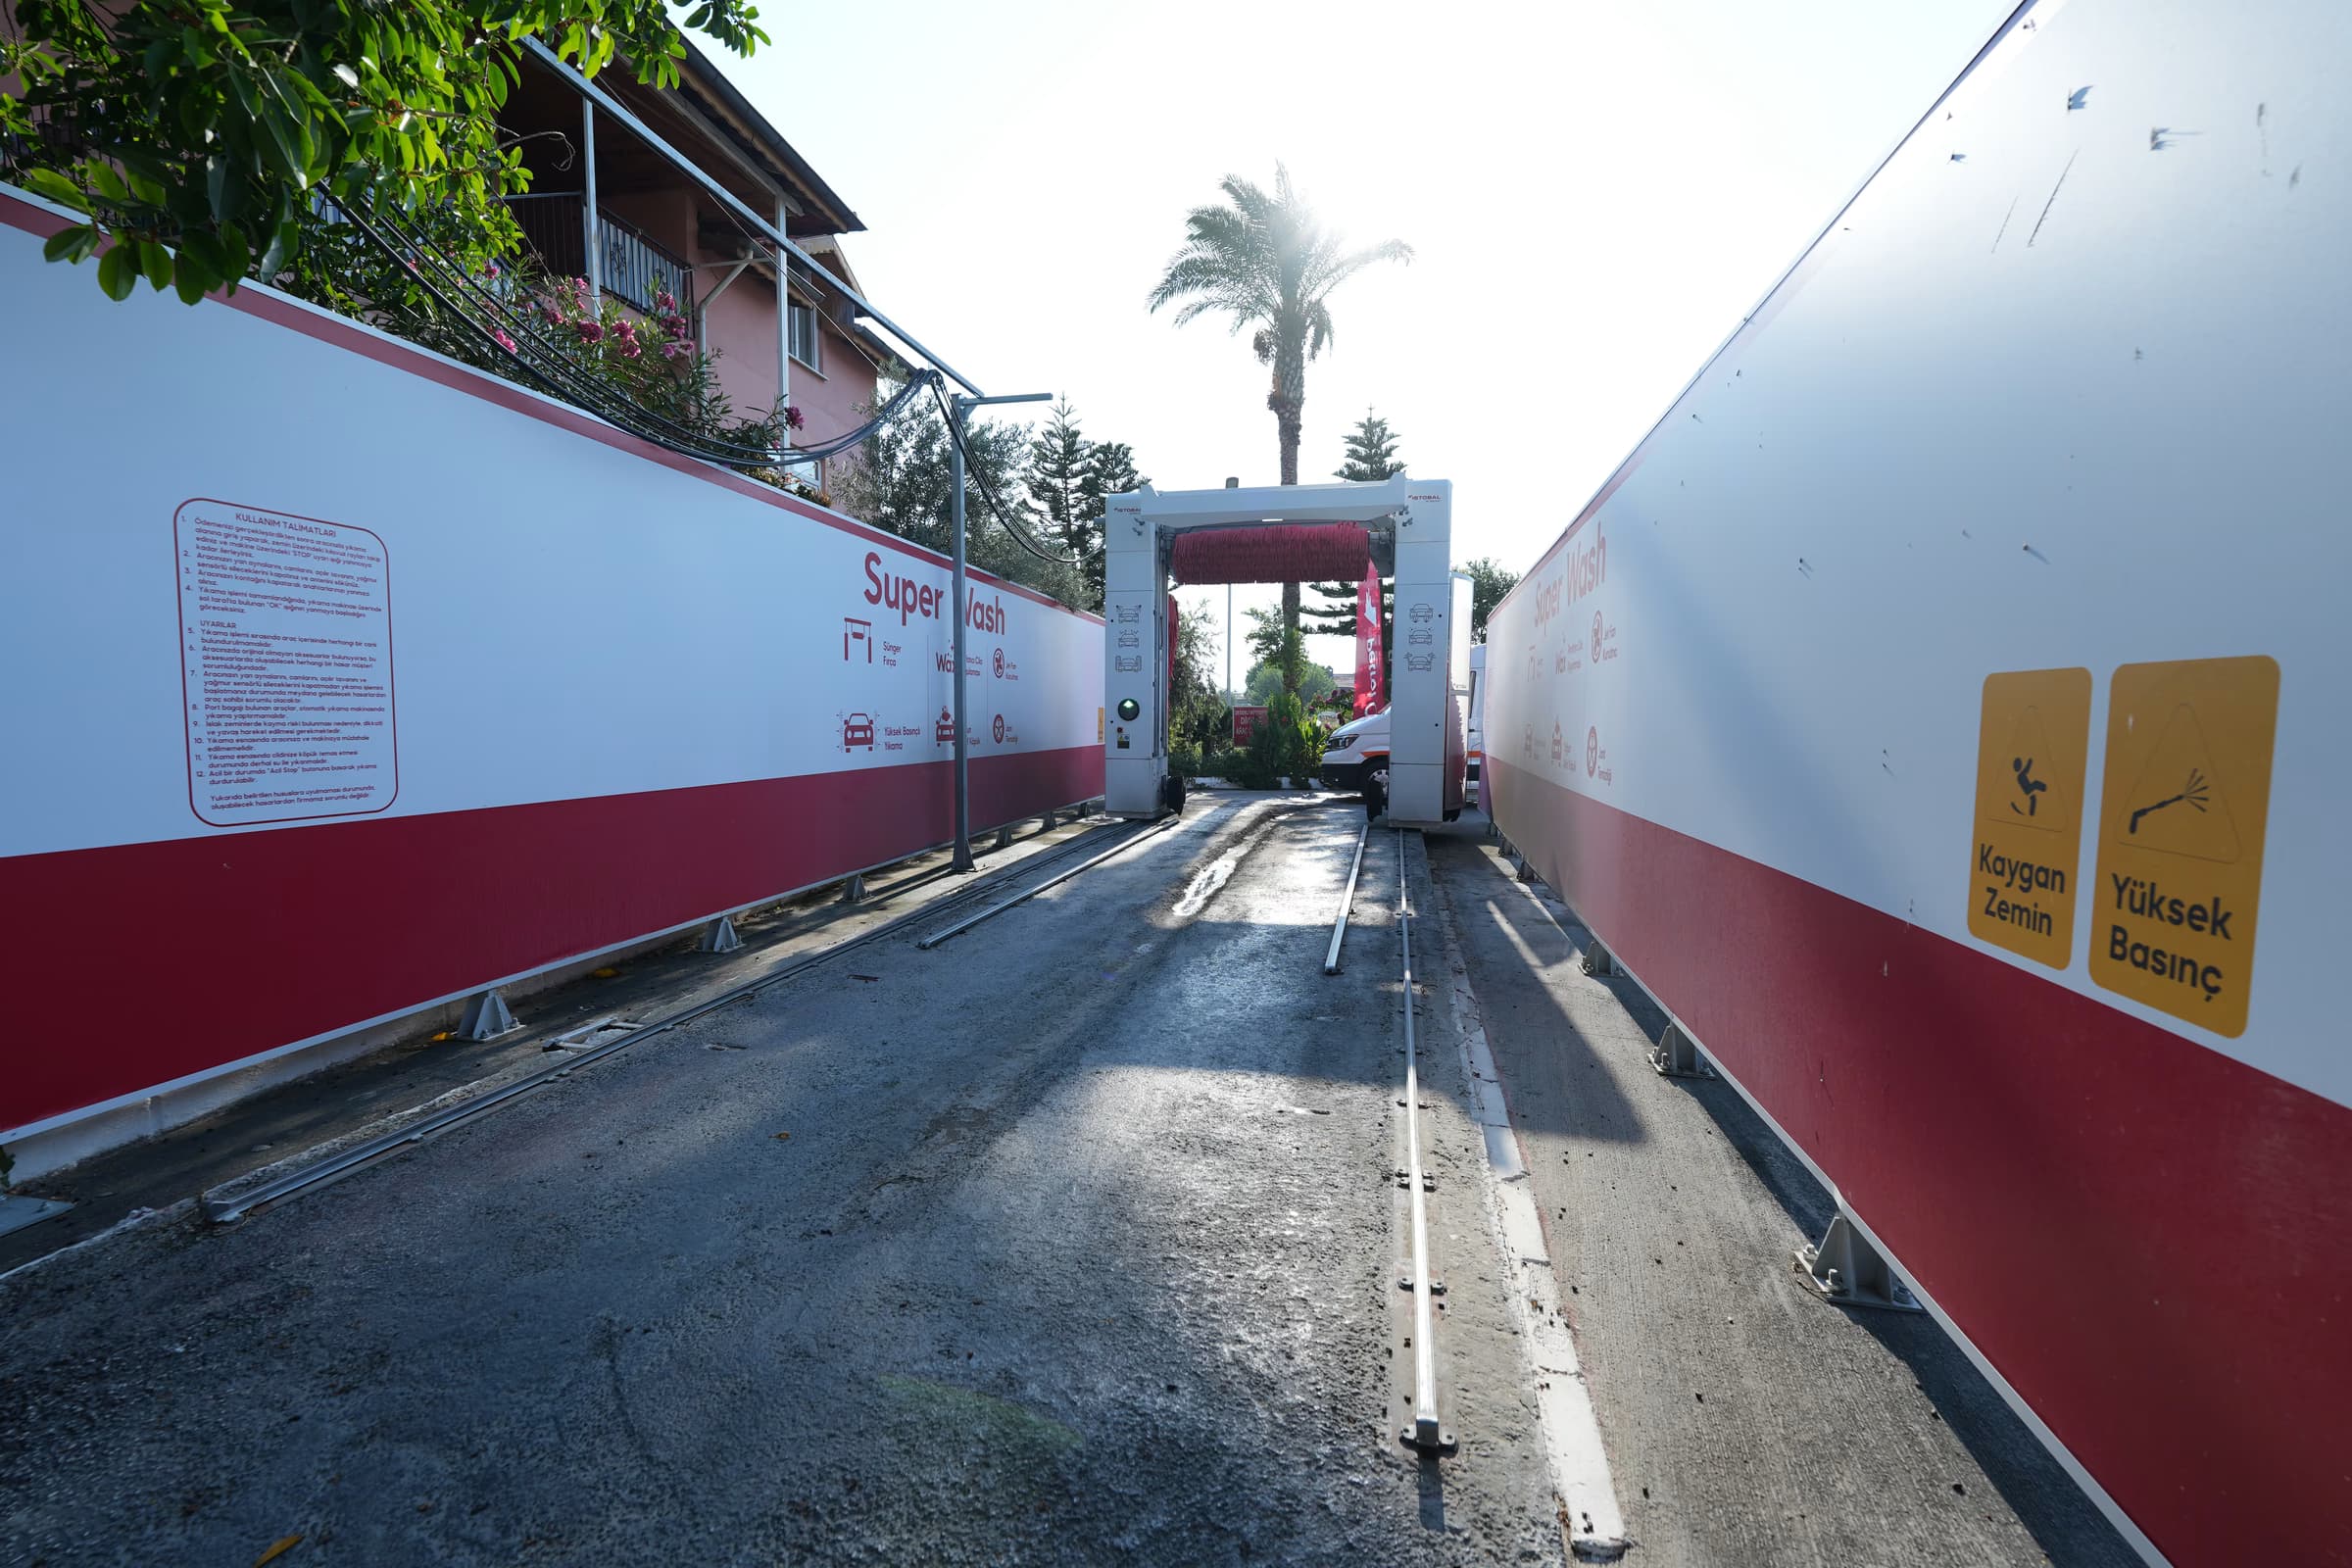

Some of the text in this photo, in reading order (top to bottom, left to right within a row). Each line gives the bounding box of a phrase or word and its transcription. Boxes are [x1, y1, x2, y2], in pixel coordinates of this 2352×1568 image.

[235, 513, 280, 528] KULLANIM
[864, 552, 944, 626] Super
[1535, 574, 1563, 636] Super
[1567, 520, 1606, 607] Wash
[883, 641, 902, 656] Sünger
[884, 726, 902, 737] Yüksek
[1980, 843, 2065, 894] Kaygan
[1984, 886, 2052, 937] Zemin
[2111, 872, 2233, 941] Yüksek
[2109, 924, 2223, 1003] Basınç
